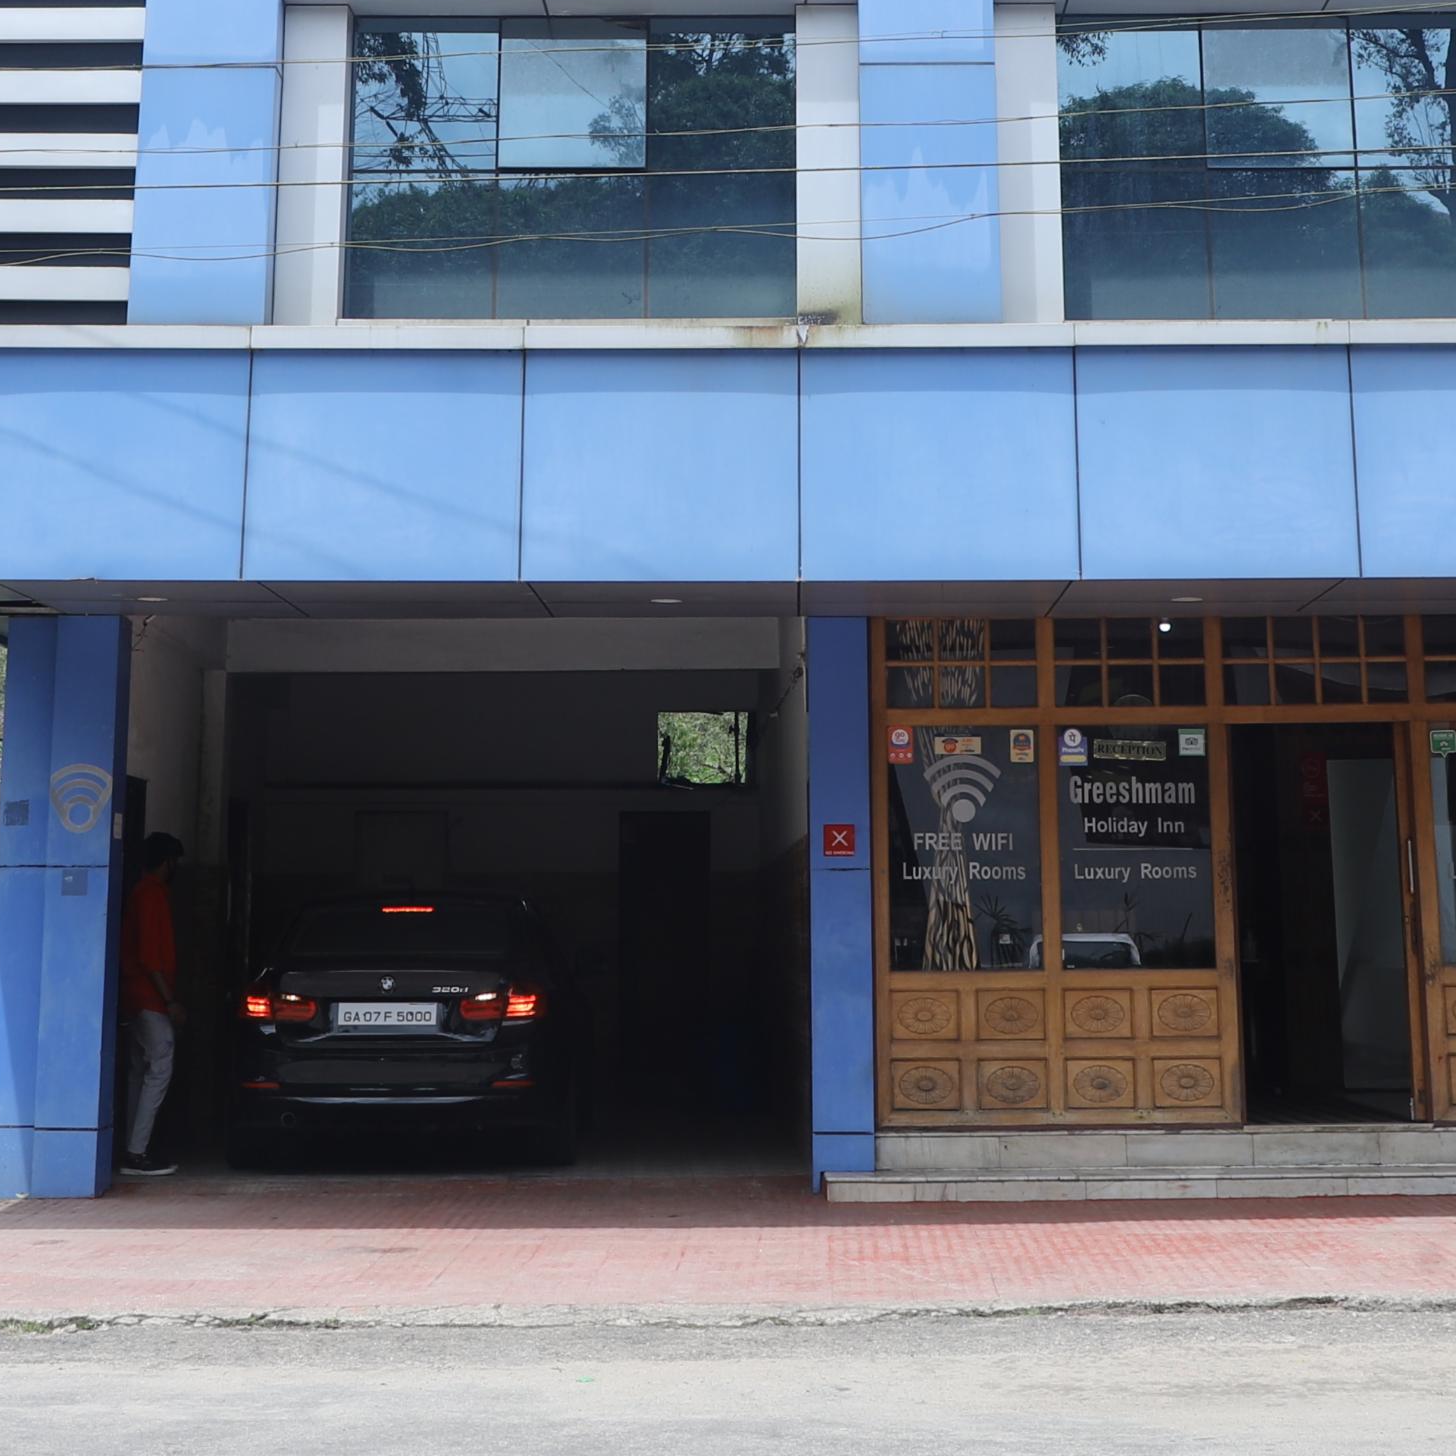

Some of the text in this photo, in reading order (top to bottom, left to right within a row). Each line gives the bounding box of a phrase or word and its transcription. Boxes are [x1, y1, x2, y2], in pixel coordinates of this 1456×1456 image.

[1097, 743, 1163, 755] RECEPTION
[1069, 775, 1196, 804] Greeshmam
[1084, 817, 1185, 837] Holiday Inn
[913, 833, 1013, 850] FREE WIFI
[903, 862, 1026, 885] Luxury Rooms
[1074, 863, 1197, 883] Luxury Rooms
[397, 1011, 432, 1022] 5000
